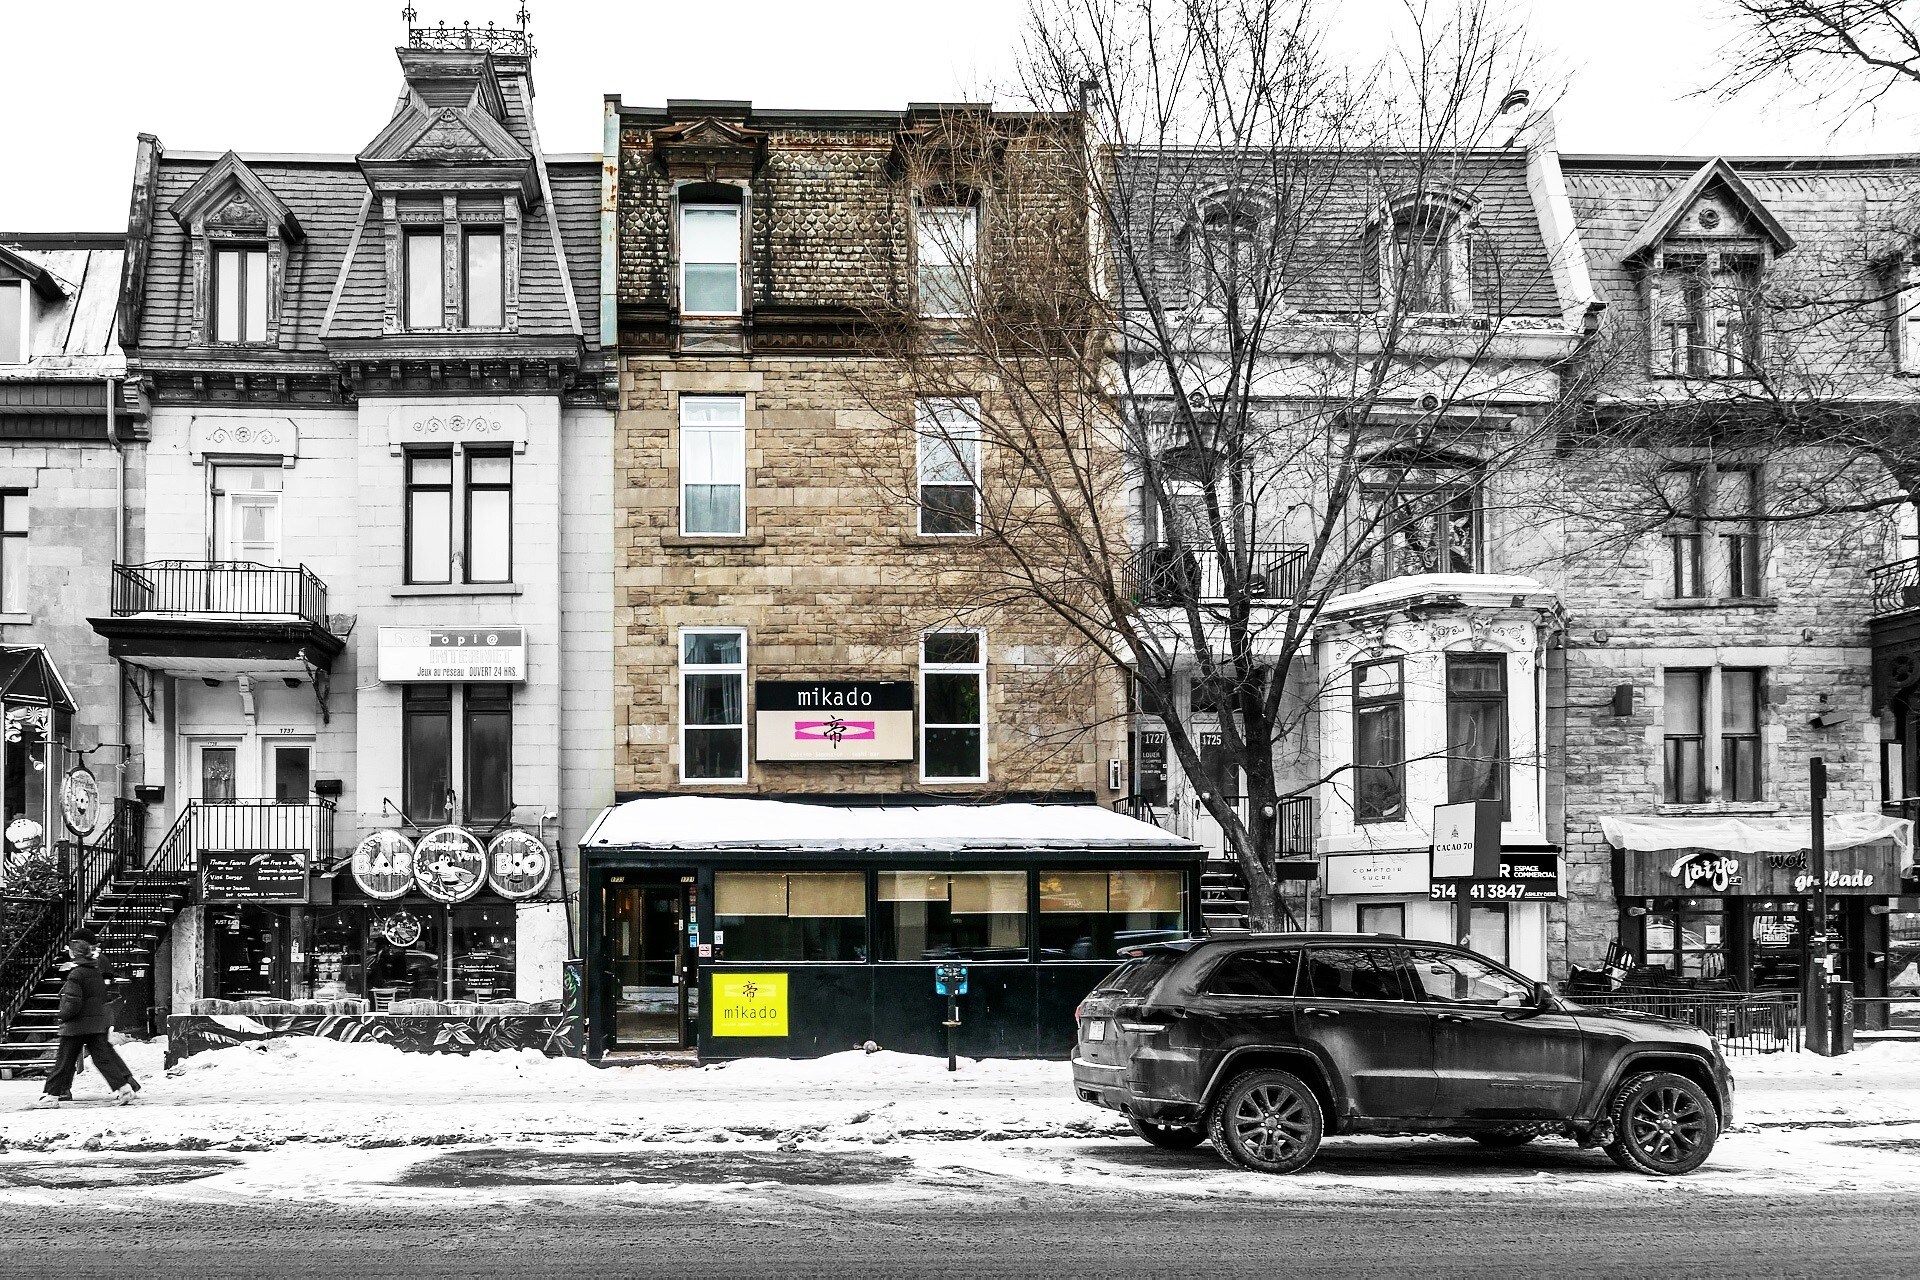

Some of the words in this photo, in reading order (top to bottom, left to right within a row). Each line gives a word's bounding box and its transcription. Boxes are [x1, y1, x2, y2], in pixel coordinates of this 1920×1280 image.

[430, 650, 512, 663] INTERNET
[417, 666, 431, 677] Jeux
[433, 668, 441, 677] au
[469, 666, 492, 677] OUVERT
[493, 666, 502, 677] 24
[504, 666, 518, 677] HRS.
[797, 687, 872, 706] mikado
[1145, 733, 1165, 744] 1727
[1202, 734, 1222, 745] 1725
[1436, 843, 1462, 852] CACAO
[1463, 842, 1473, 850] 70
[352, 851, 412, 877] BAR
[494, 852, 545, 877] BIO
[1767, 850, 1808, 870] wok
[1670, 853, 1739, 892] Taiyo
[1430, 883, 1457, 899] 514
[1470, 884, 1485, 899] 41
[1487, 884, 1526, 899] 3847
[724, 1006, 777, 1019] mikado
